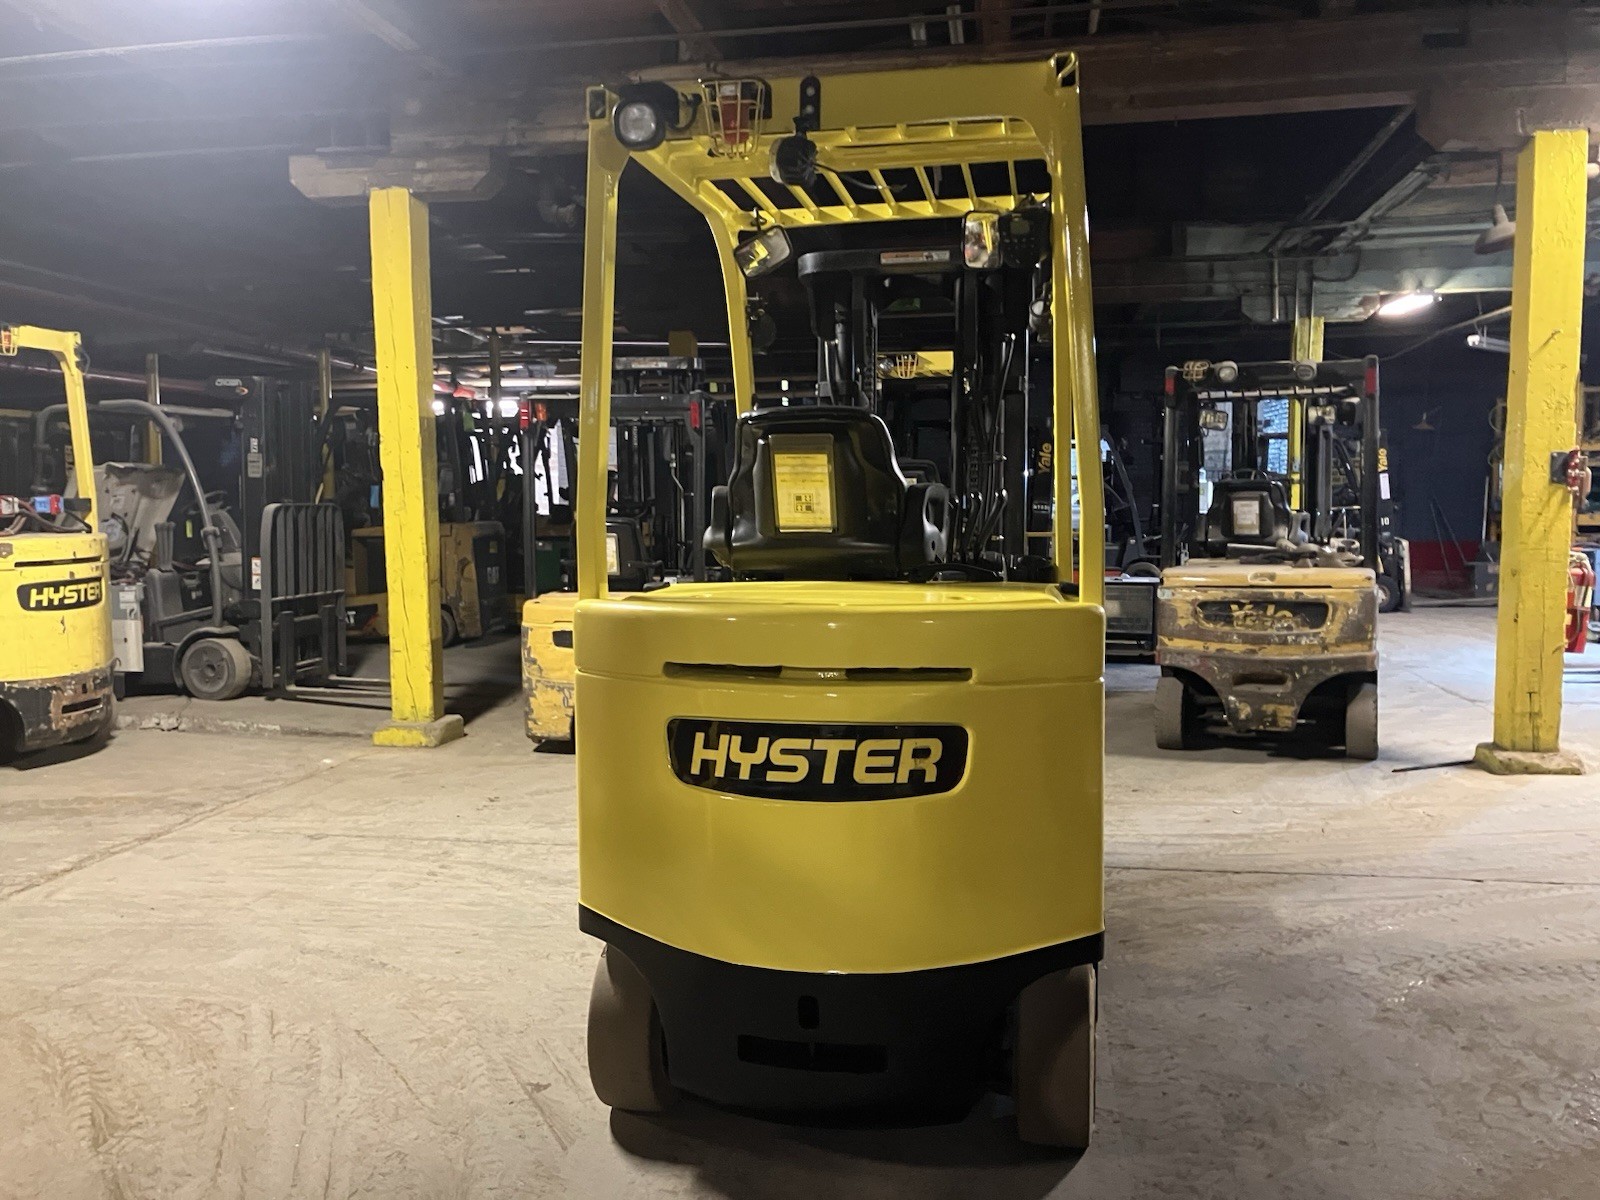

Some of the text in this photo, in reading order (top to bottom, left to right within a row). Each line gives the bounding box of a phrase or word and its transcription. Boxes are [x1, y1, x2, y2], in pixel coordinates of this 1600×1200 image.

[1037, 442, 1052, 474] Yale
[1377, 448, 1388, 473] Yale
[29, 581, 101, 608] HYSTER
[689, 731, 943, 785] HYSTER
